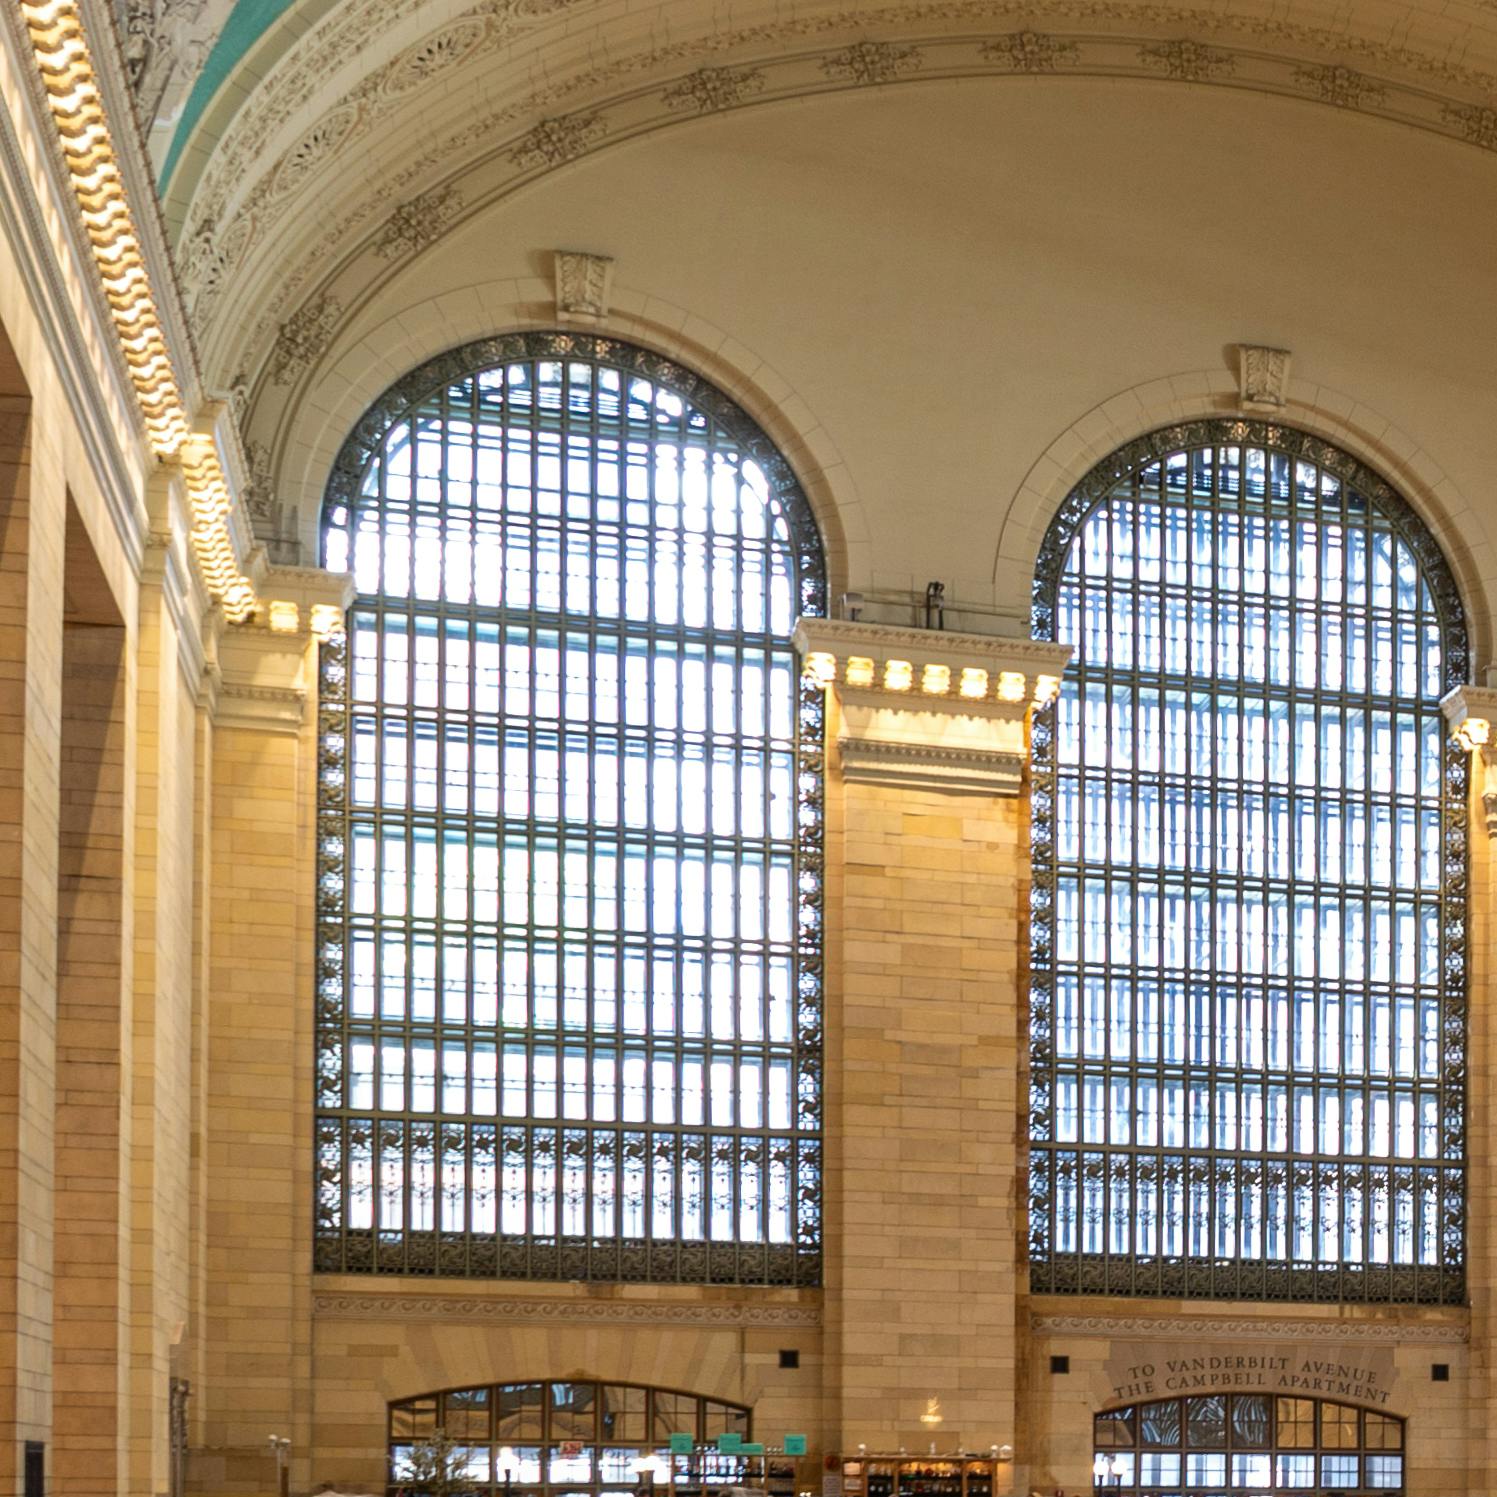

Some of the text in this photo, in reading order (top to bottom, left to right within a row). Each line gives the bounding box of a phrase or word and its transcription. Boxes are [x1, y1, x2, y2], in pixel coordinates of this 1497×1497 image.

[1128, 1356, 1377, 1384] TO VANDERBILT AVENUE
[1113, 1372, 1390, 1403] THE CAMPBELL APARTMENT
